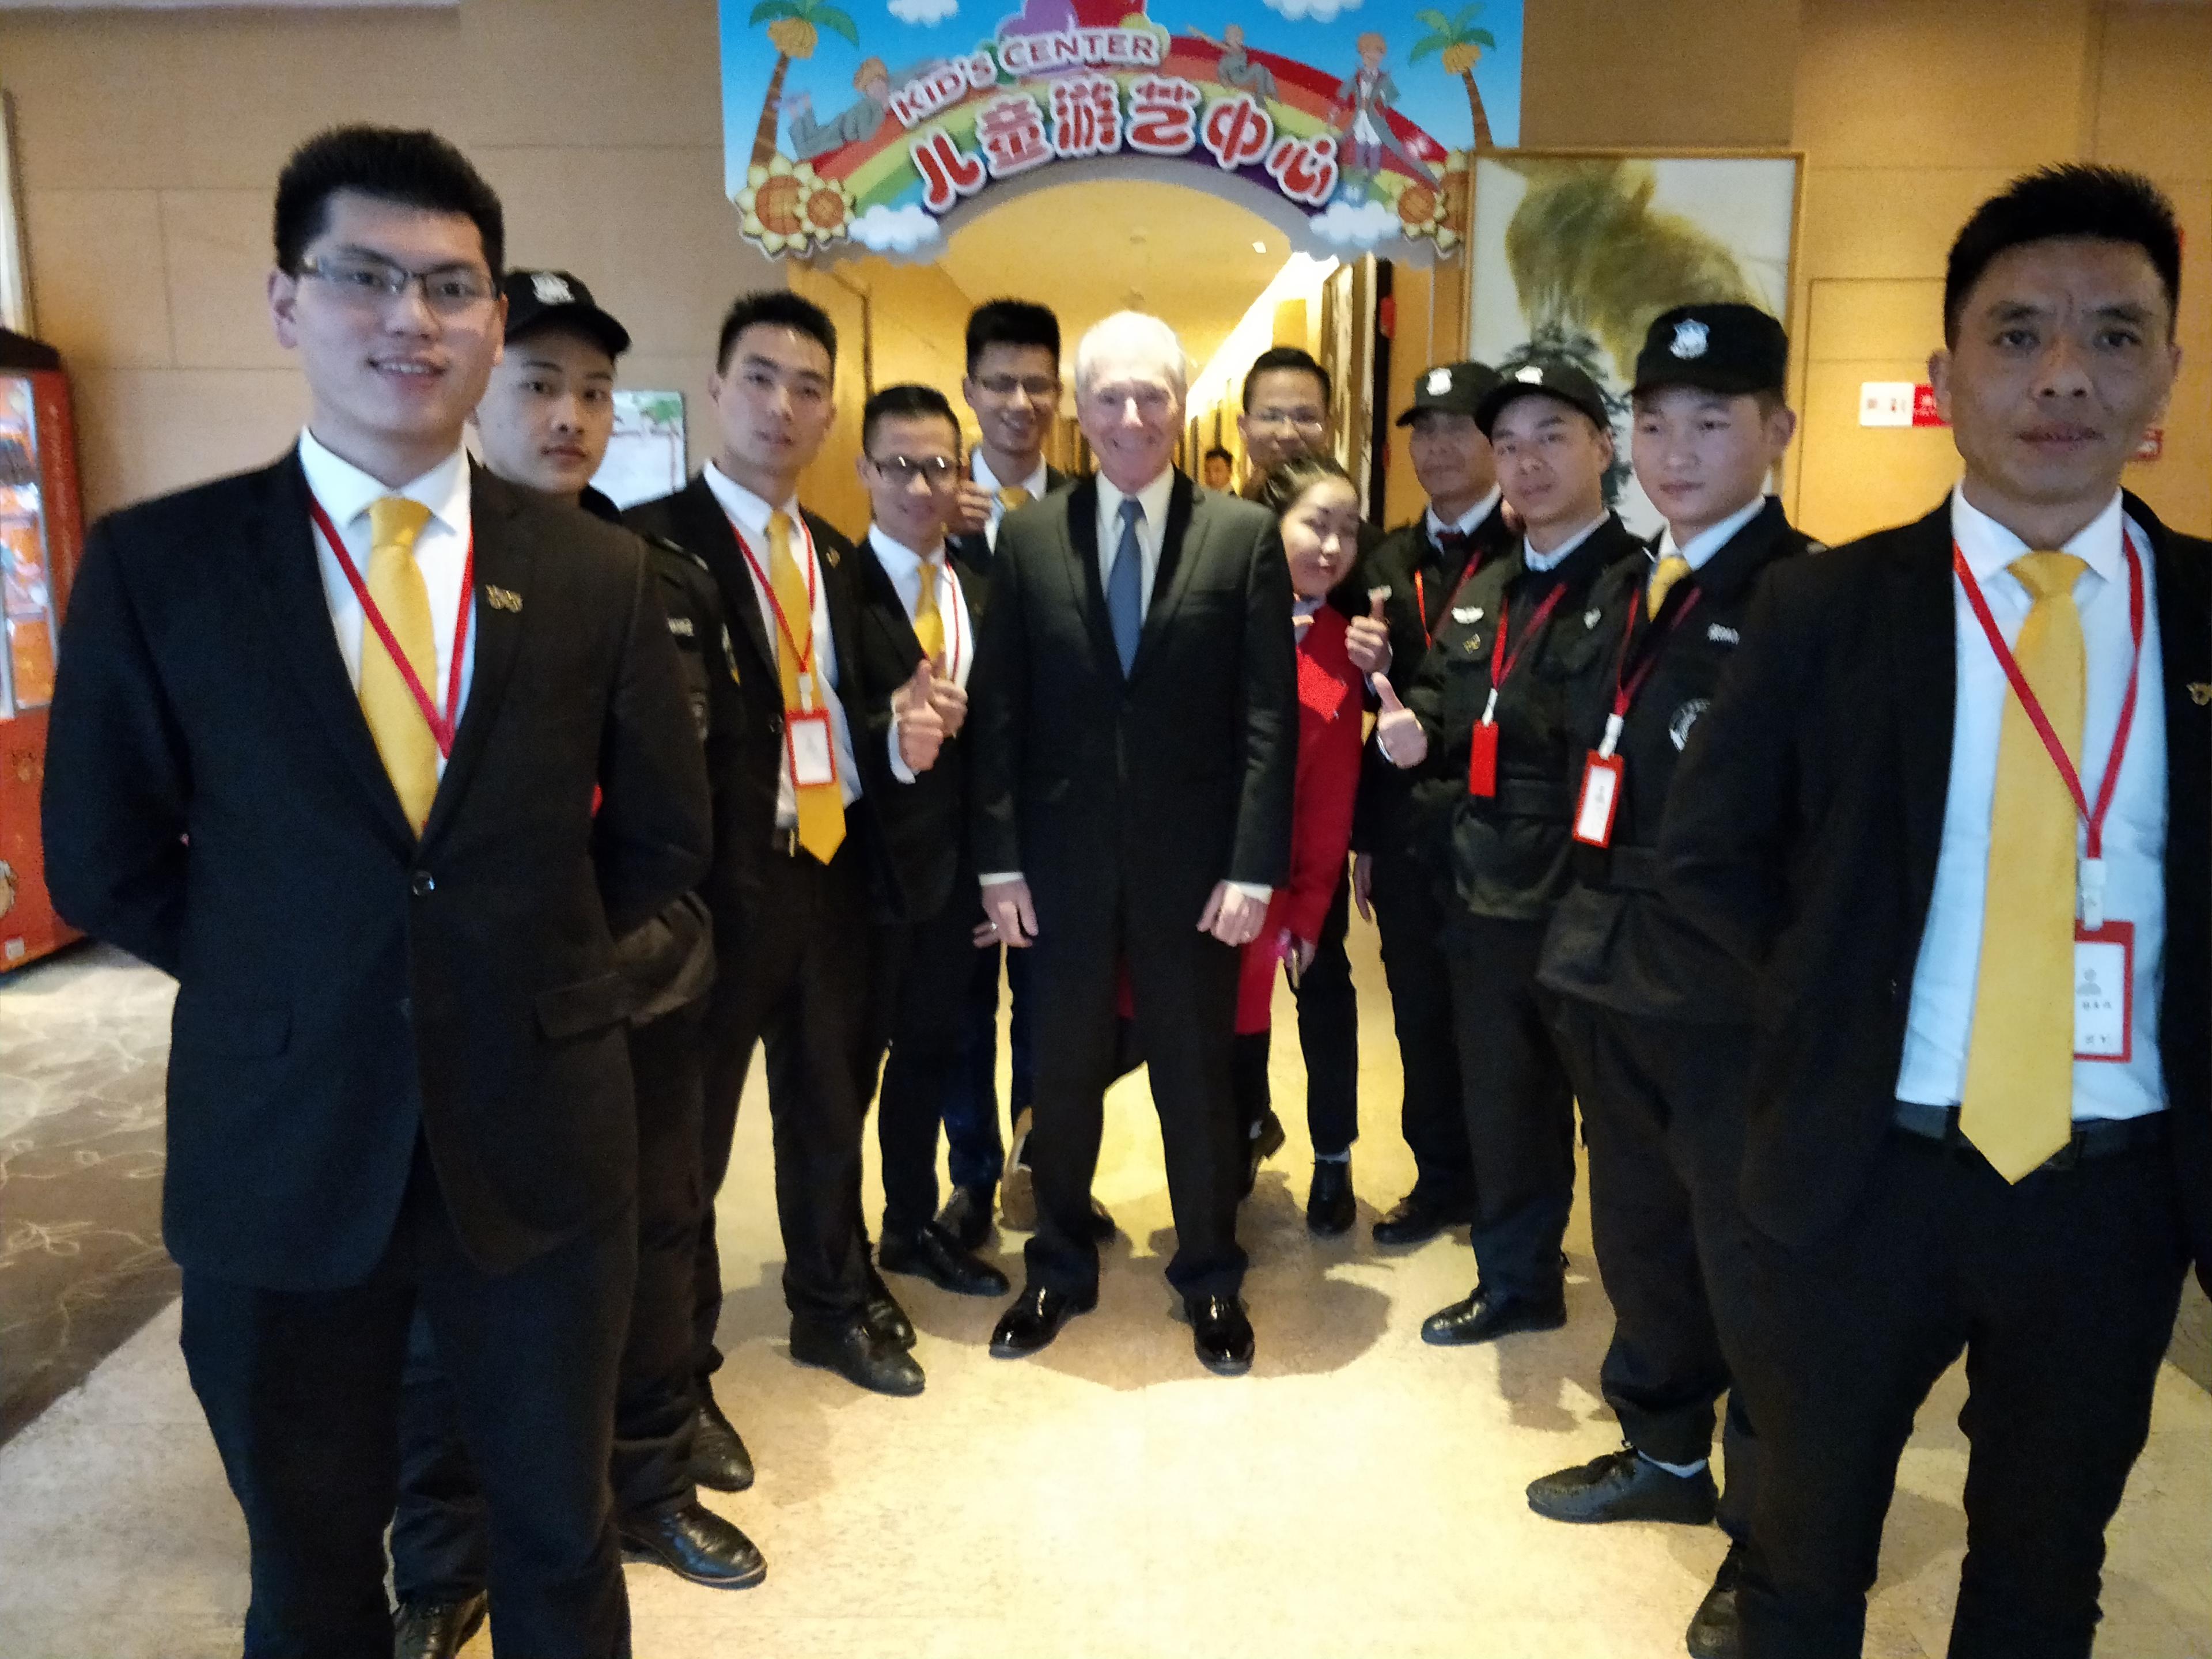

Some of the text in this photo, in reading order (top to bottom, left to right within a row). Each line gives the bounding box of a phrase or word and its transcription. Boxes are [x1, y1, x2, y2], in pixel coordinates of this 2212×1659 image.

[1001, 29, 1158, 71] CENTER
[912, 76, 1336, 210] 儿童游艺中心
